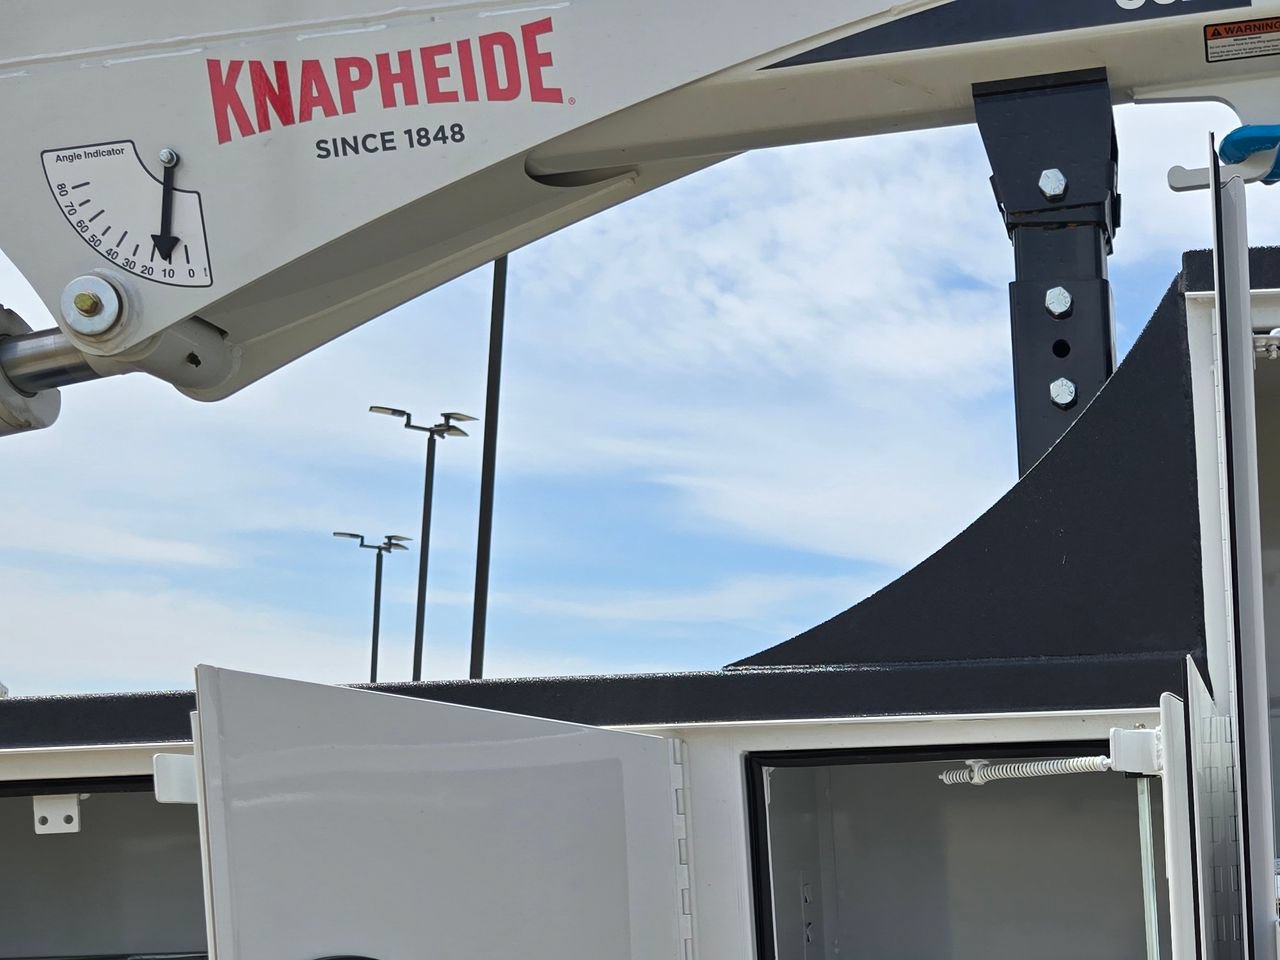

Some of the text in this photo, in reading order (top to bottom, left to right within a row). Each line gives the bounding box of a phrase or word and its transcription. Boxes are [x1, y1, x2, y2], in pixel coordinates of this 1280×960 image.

[206, 16, 564, 145] KNAPHEIDE
[315, 123, 466, 159] SINCE 1848
[55, 147, 125, 163] Angle Indicator
[56, 183, 69, 197] 80
[64, 202, 77, 216] 70
[76, 219, 89, 233] 60
[88, 234, 102, 248] 50
[105, 248, 119, 260] 40
[122, 257, 136, 270] 30
[140, 265, 154, 276] 20
[161, 268, 175, 278] 10
[188, 268, 195, 278] 0
